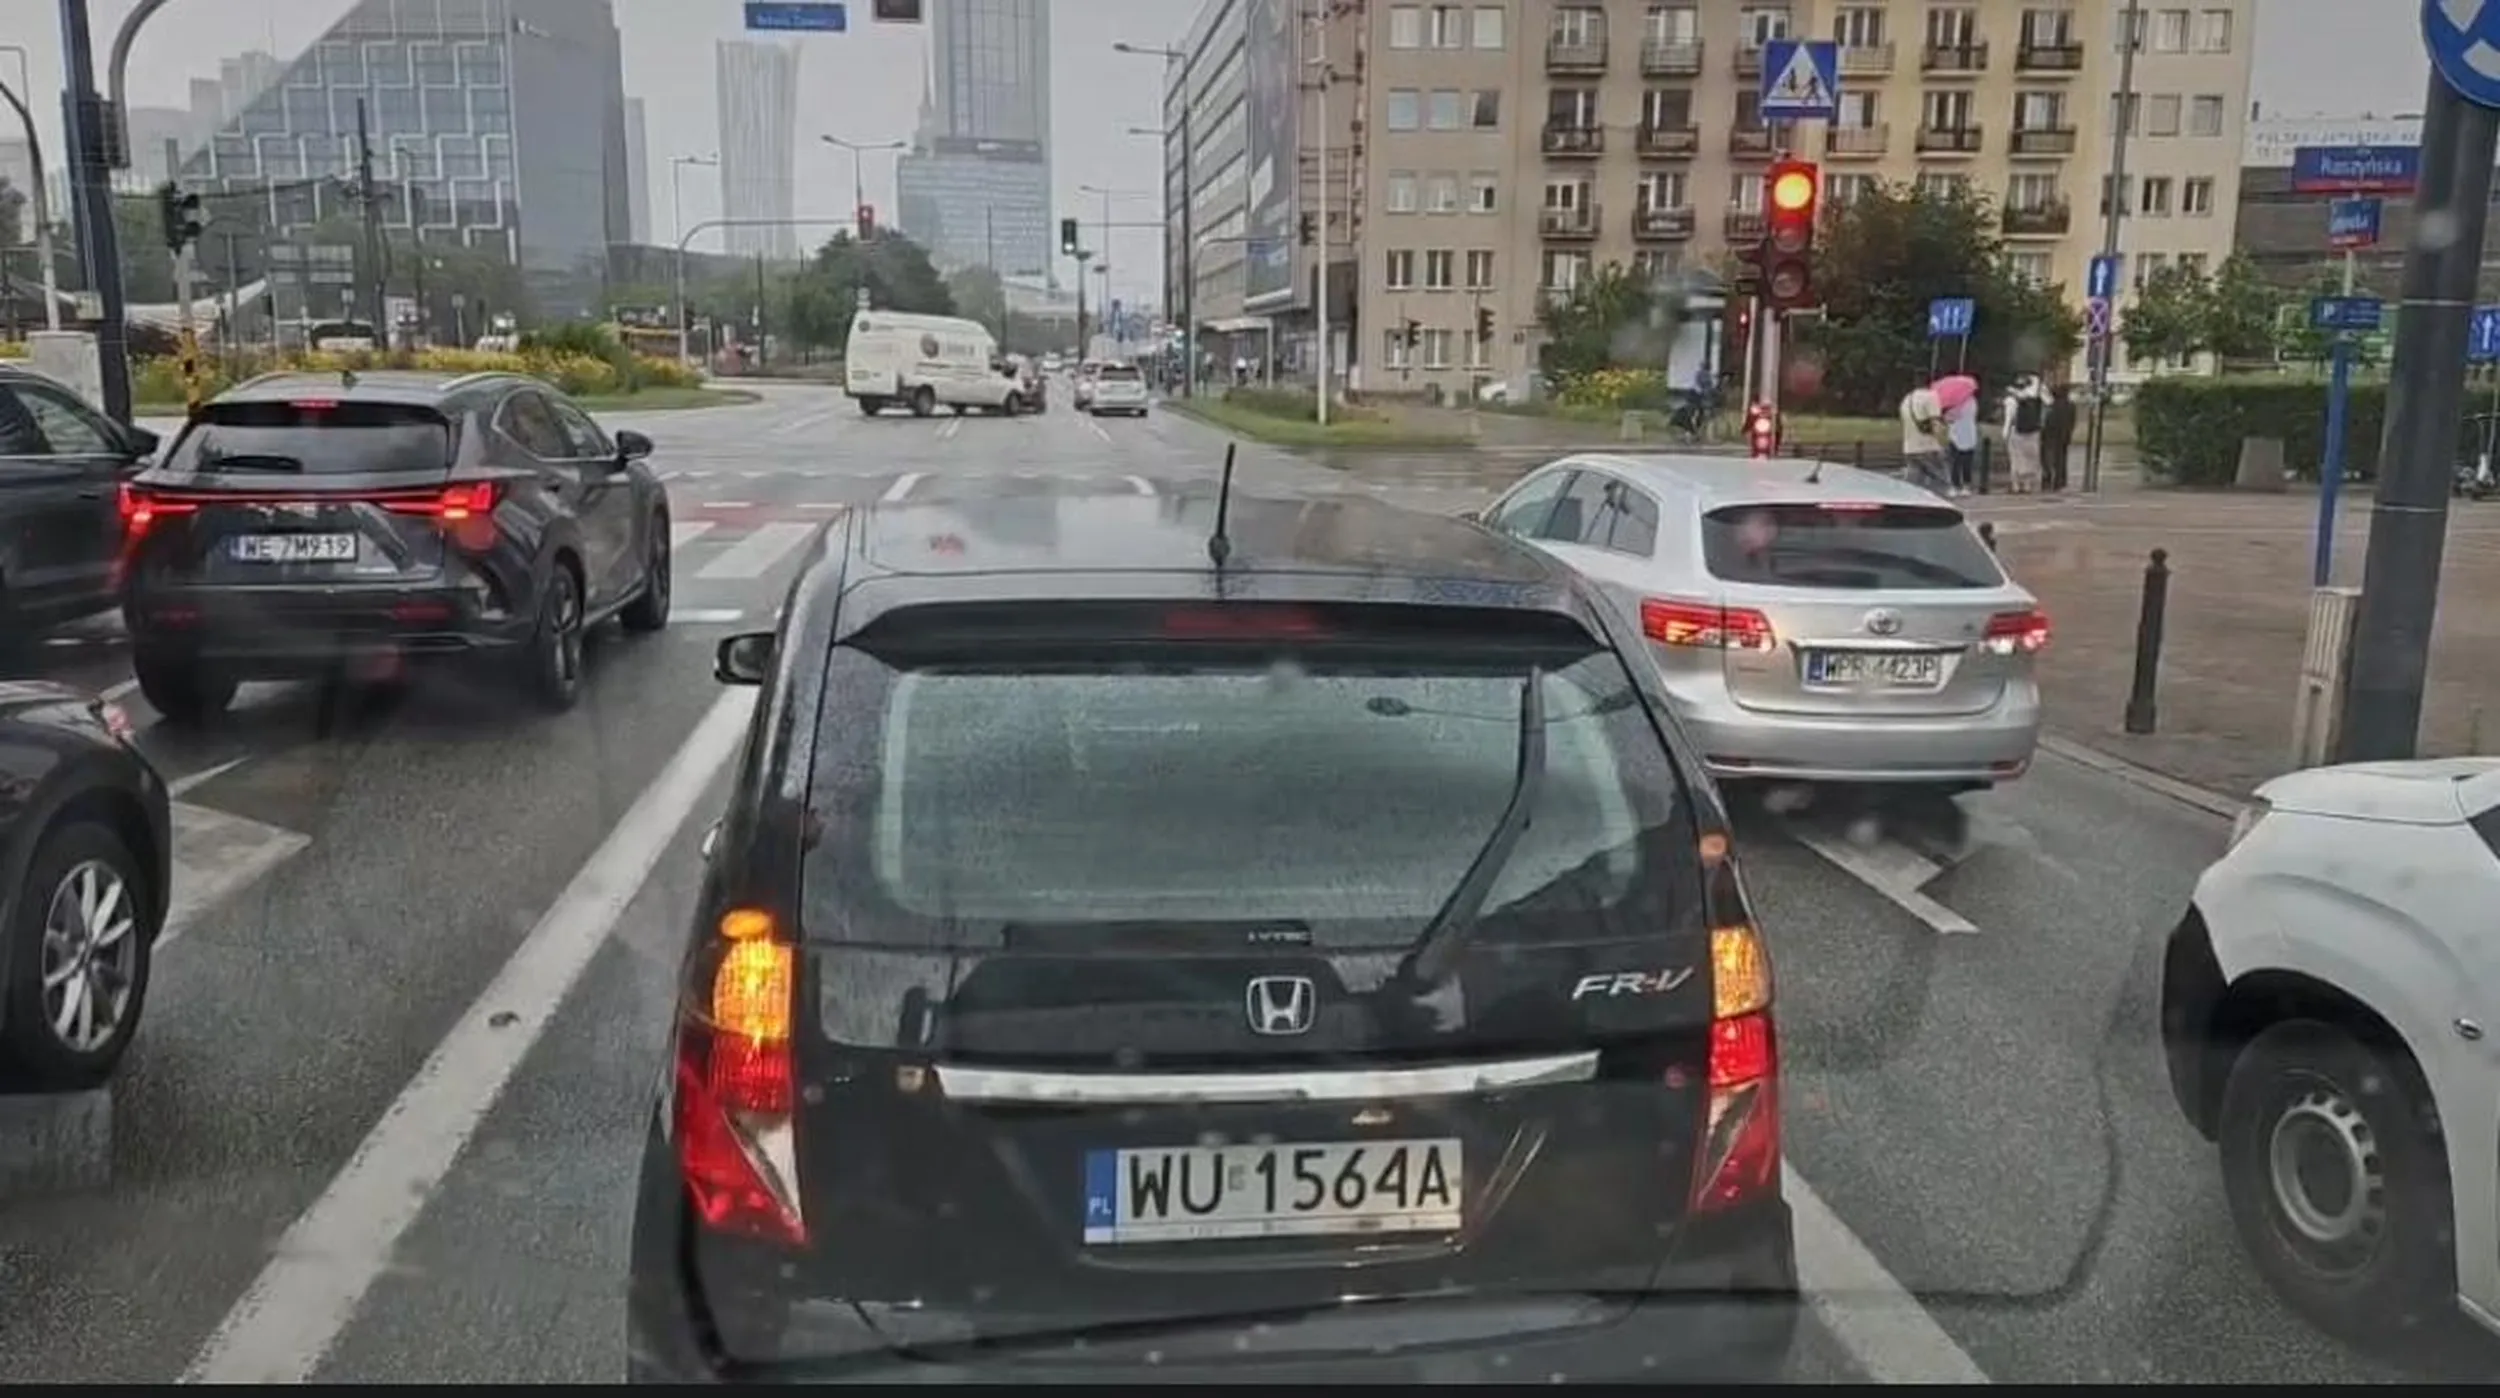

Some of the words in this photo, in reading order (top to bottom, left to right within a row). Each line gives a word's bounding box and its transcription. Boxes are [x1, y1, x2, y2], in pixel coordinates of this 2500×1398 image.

[2321, 155, 2402, 180] Raszyńska
[245, 535, 270, 557] WE
[277, 535, 351, 557] 7M919
[1571, 965, 1695, 1001] FR-V
[1129, 1152, 1224, 1218] WU
[1255, 1145, 1451, 1213] 1564A
[1089, 1198, 1112, 1216] PL
